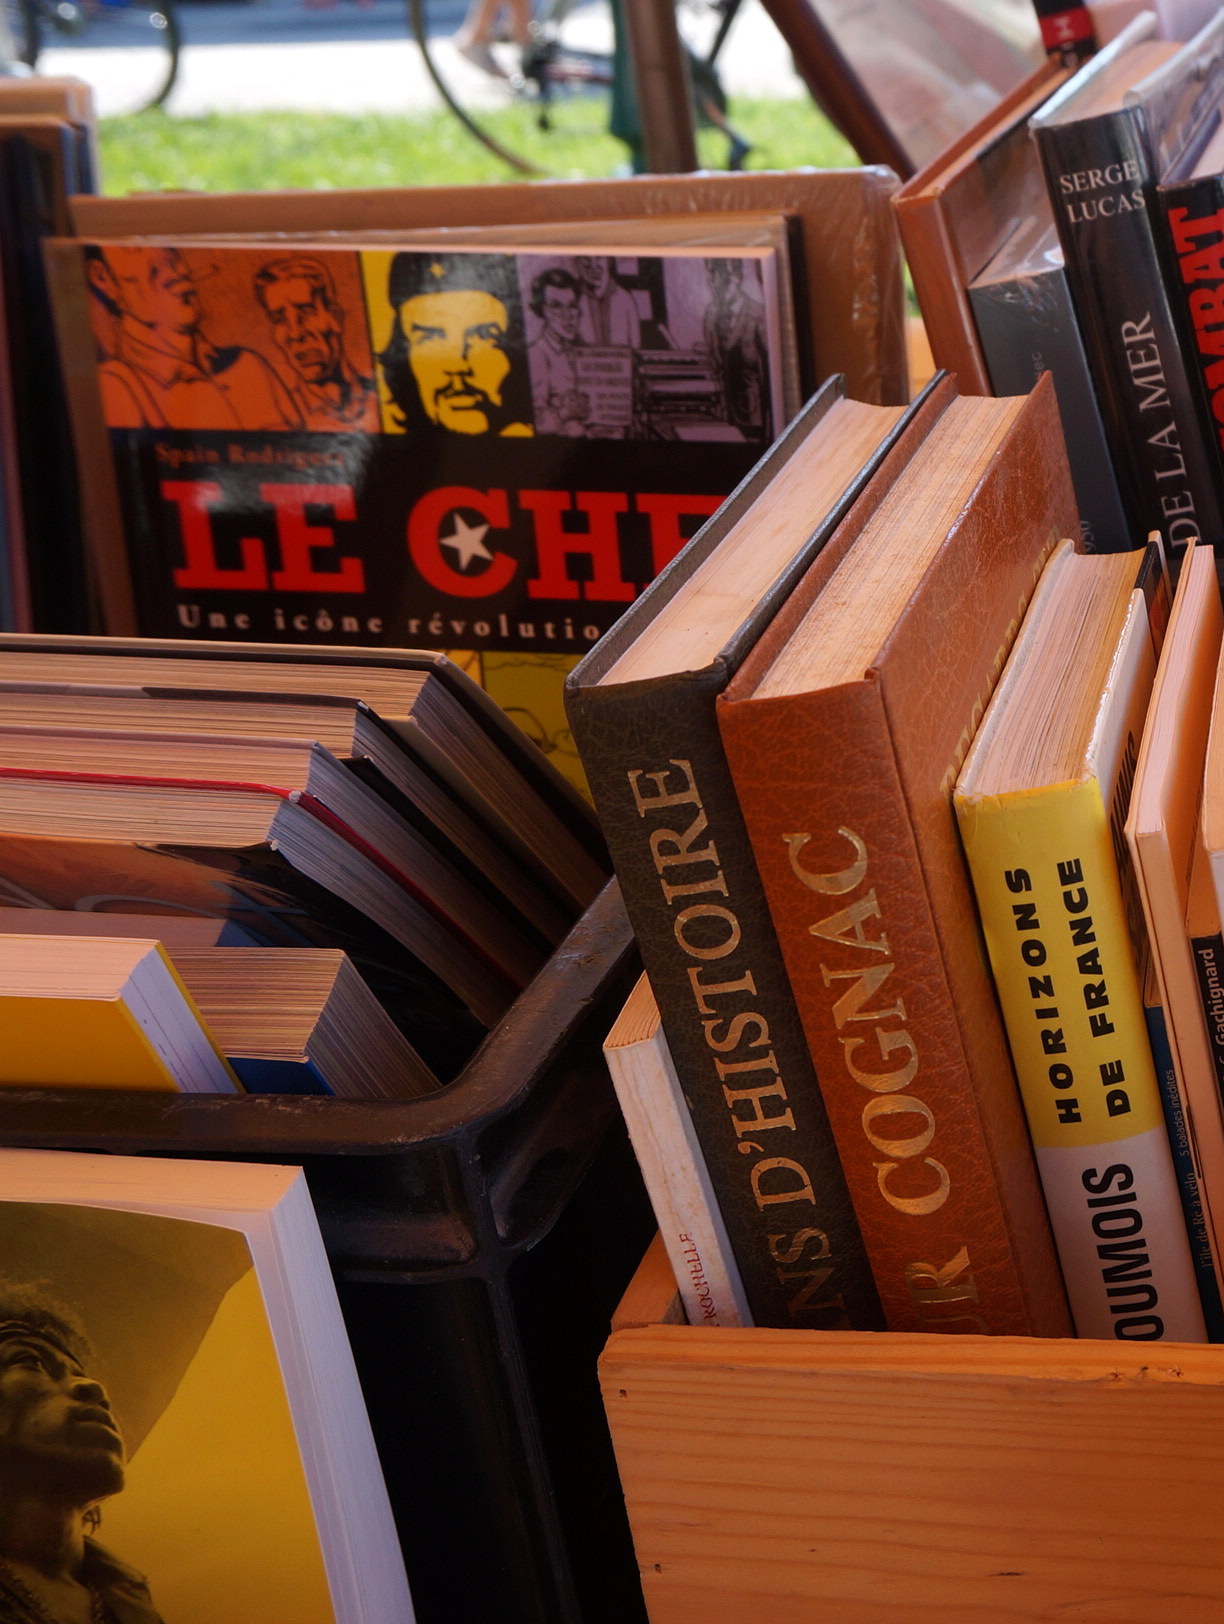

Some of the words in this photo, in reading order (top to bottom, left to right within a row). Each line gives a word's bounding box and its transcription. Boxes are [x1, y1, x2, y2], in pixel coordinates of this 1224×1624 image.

[1060, 160, 1140, 194] SERGE
[1067, 188, 1147, 224] LUCAS
[1121, 311, 1171, 414] MER
[1147, 420, 1187, 483] LA
[160, 480, 367, 592] LE
[1161, 490, 1201, 548] DE
[176, 603, 252, 630] Une
[274, 606, 384, 634] icône
[407, 611, 601, 640] révolutio
[627, 757, 817, 1212] D'HISTOIRE
[1056, 857, 1116, 1037] FRANCE
[781, 824, 951, 1217] COGNAC
[1004, 867, 1082, 1125] HORIZONS
[1099, 1057, 1132, 1118] DE
[1163, 1068, 1182, 1109] inédites
[1171, 1109, 1189, 1149] balades
[678, 1232, 717, 1321] ROCHELLE
[1081, 1161, 1165, 1341] OUMOIS
